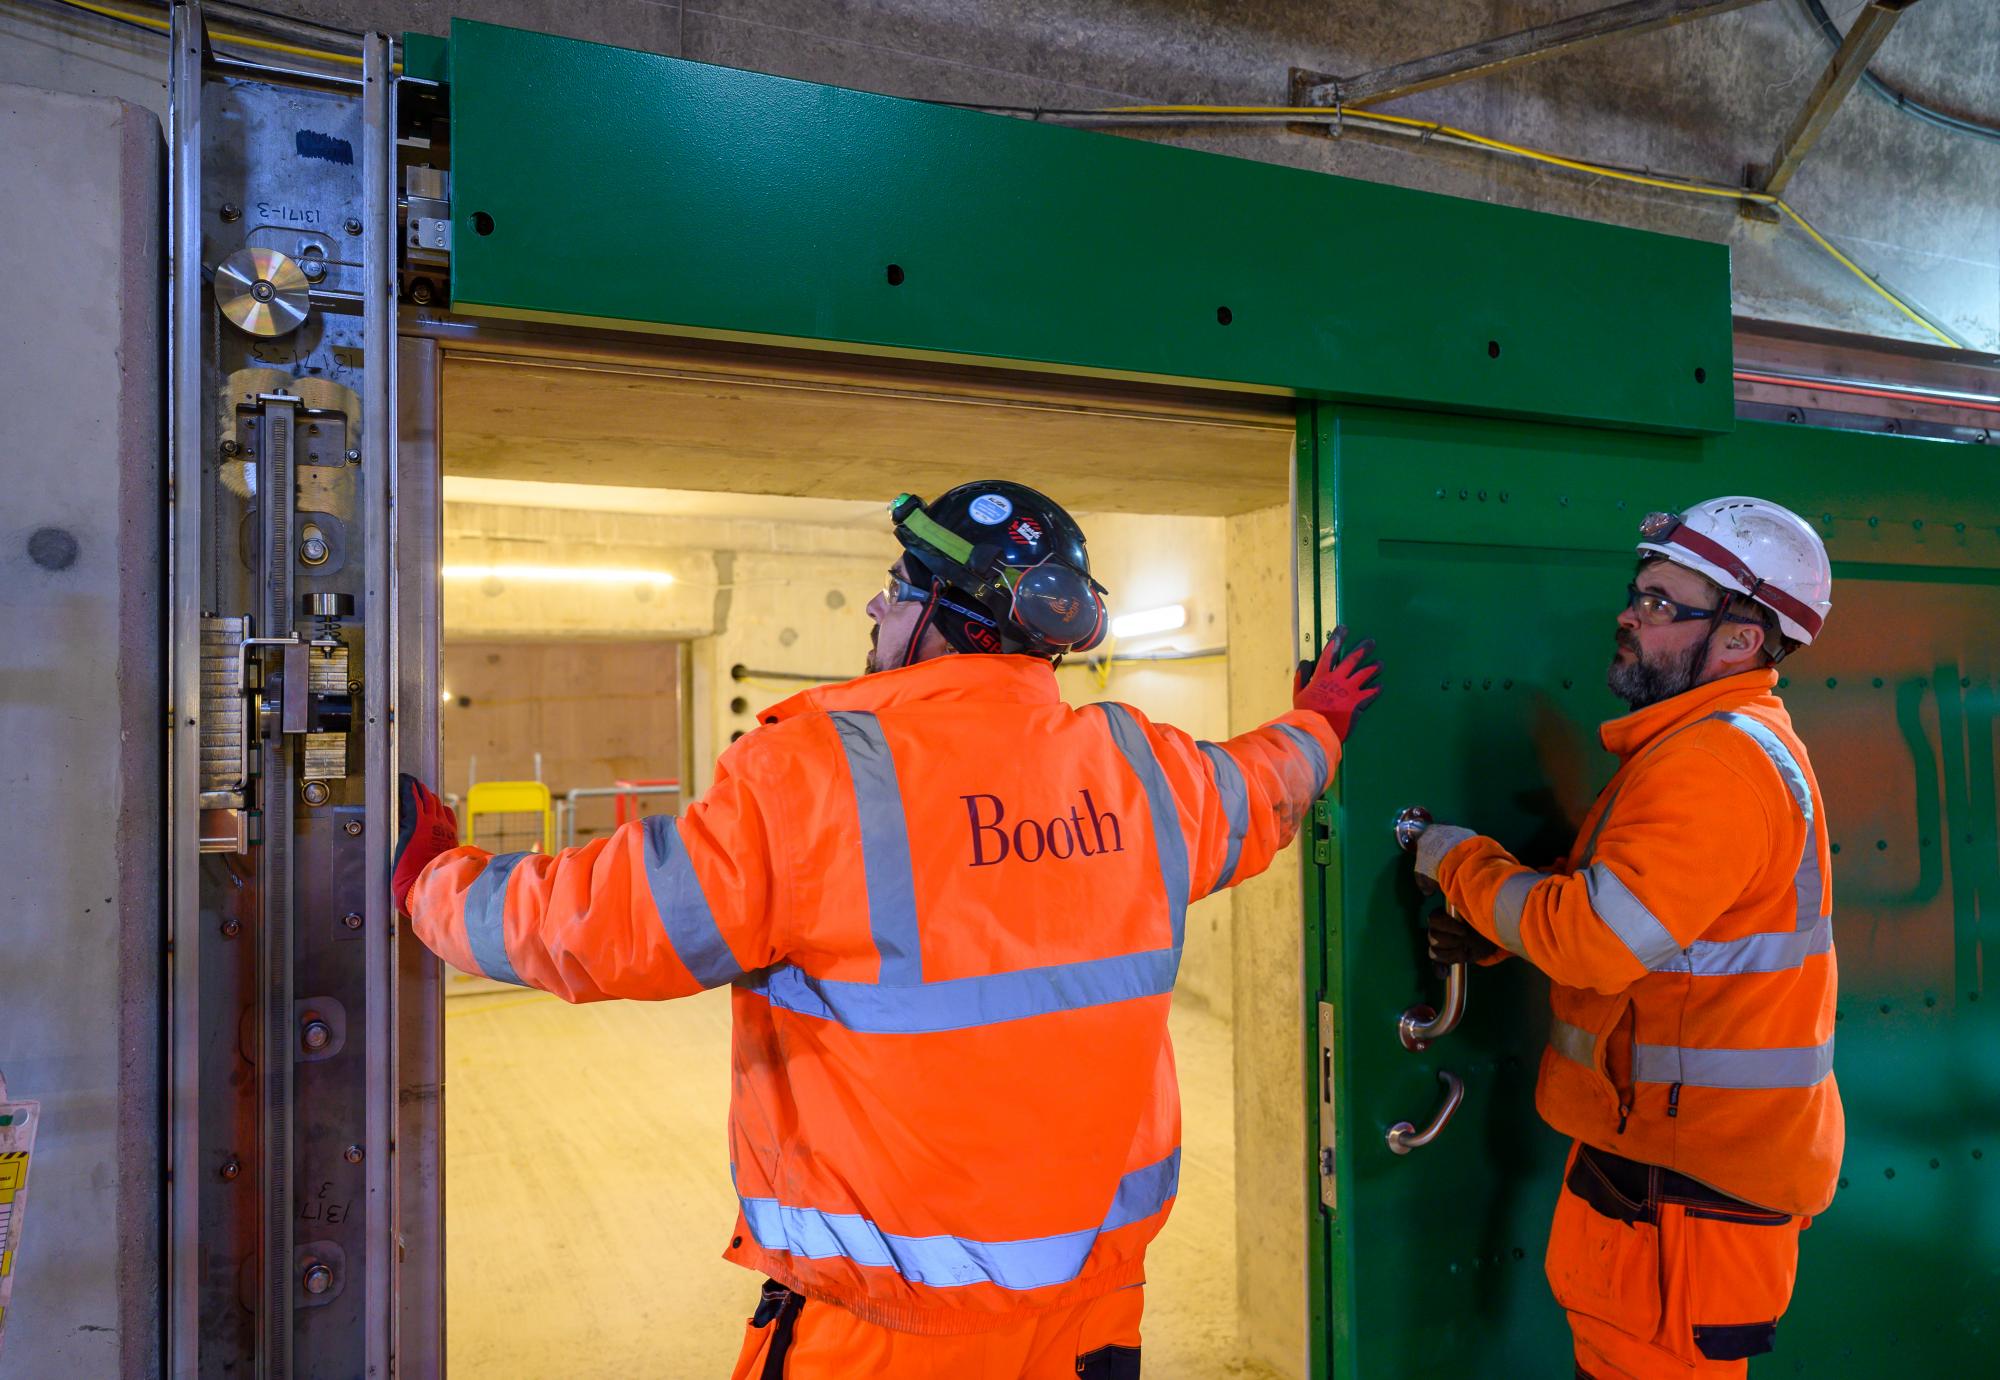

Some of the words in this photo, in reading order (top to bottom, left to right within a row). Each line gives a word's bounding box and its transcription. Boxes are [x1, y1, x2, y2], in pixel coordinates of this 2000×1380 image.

[257, 202, 320, 223] 13171-3
[252, 341, 353, 373] 13171-3
[960, 788, 1125, 867] Booth
